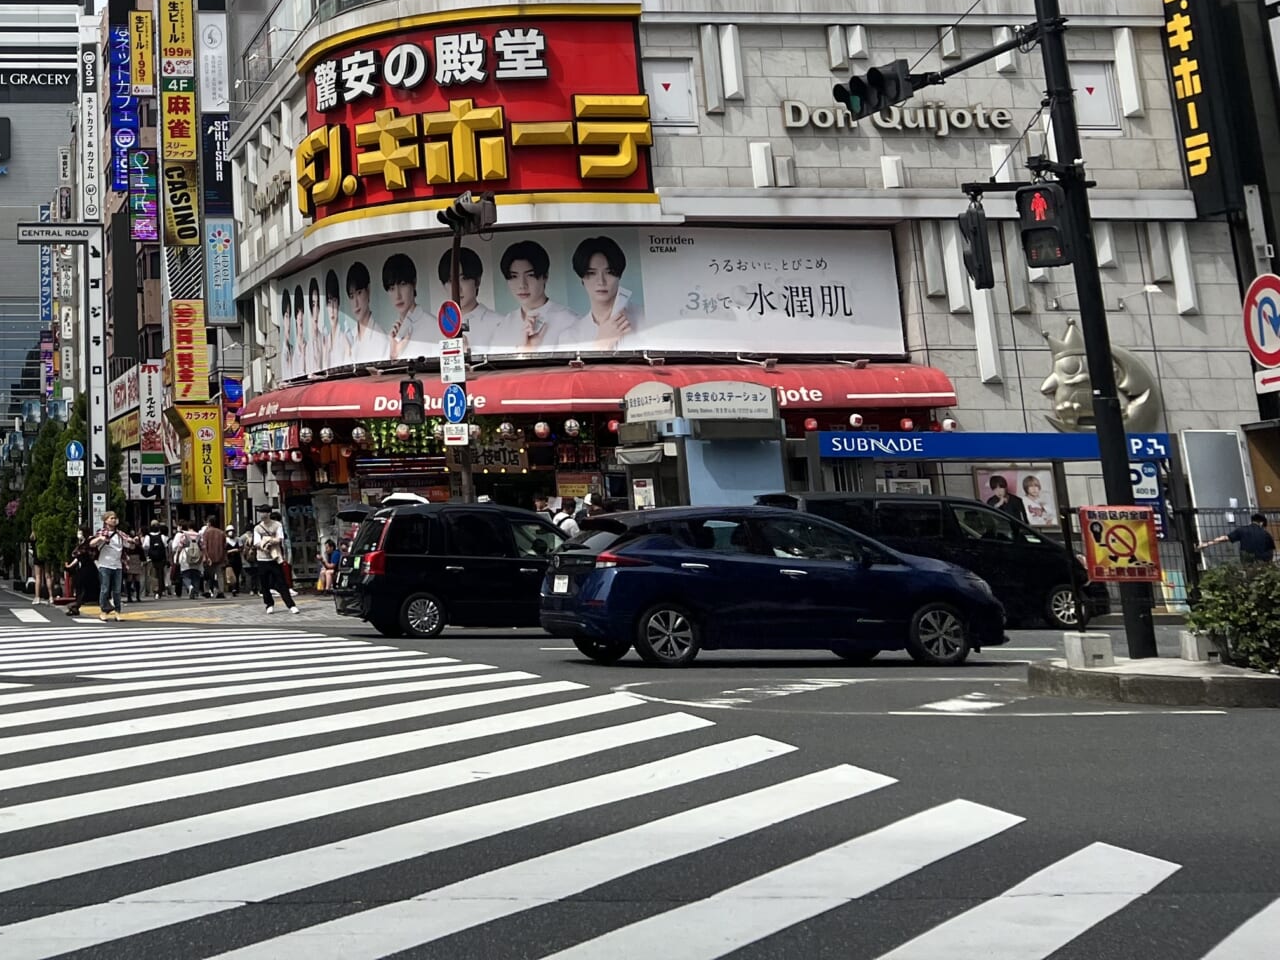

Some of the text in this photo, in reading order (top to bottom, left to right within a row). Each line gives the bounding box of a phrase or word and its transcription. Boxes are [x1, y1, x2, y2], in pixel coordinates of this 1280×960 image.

[167, 1, 180, 44] 生ビール
[135, 16, 145, 50] 生ビール
[163, 46, 192, 57] 199円
[82, 50, 96, 87] Booth
[313, 27, 550, 113] 驚安の殿堂
[9, 72, 71, 86] GRACERY
[167, 79, 189, 91] 4F
[166, 95, 193, 140] 麻雀
[869, 100, 1014, 137] Quijote
[294, 93, 655, 218] ドン・キホーテ
[165, 165, 198, 240] CASINO
[21, 229, 89, 237] CENTRAL ROAD
[648, 235, 695, 246] Torriden
[649, 246, 677, 254] &TEAM
[708, 257, 828, 275] うるおいに、とびこめ
[40, 244, 51, 317] カラオケランド
[447, 393, 457, 418] P
[685, 391, 767, 403] 安全安心ステーション
[185, 411, 217, 420] カラオケ
[831, 437, 924, 455] SUBNADE
[1130, 438, 1143, 455] P
